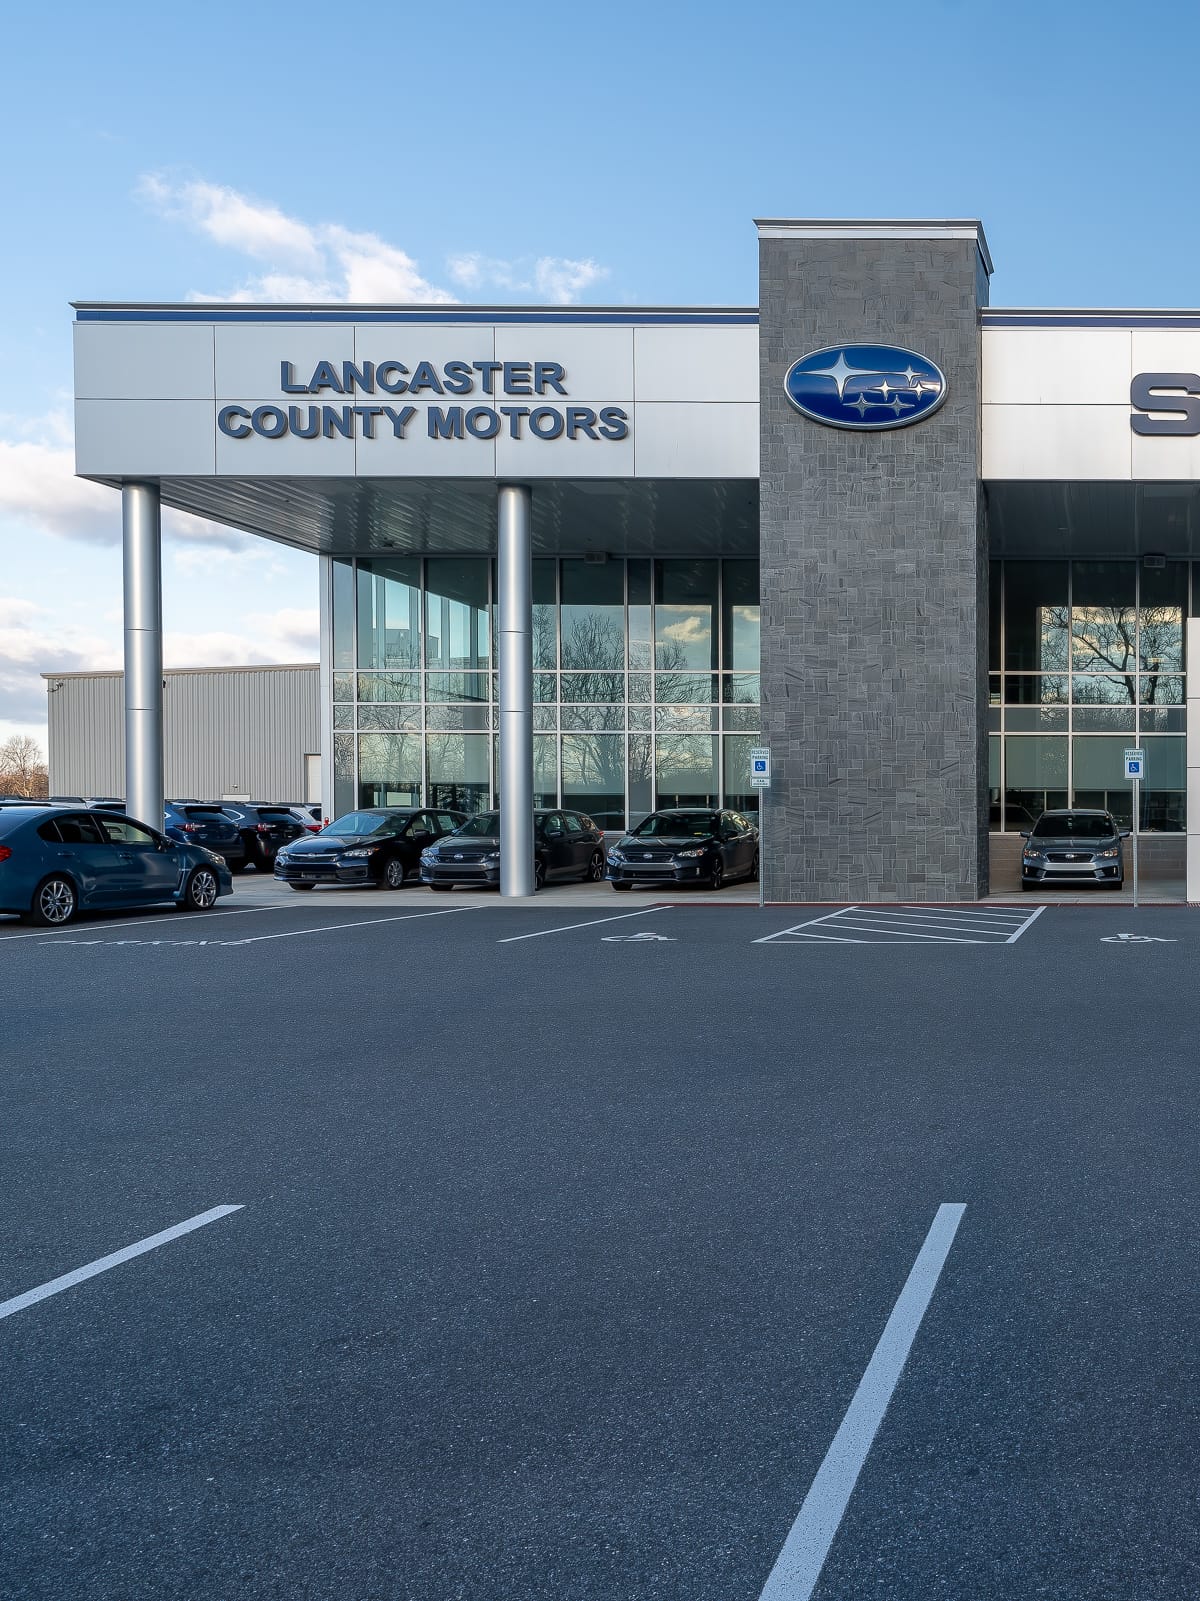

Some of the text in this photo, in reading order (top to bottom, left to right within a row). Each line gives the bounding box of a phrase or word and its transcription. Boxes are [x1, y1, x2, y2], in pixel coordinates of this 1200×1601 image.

[280, 360, 568, 396] LANCASTER
[217, 405, 629, 442] COUNTY MOTORS
